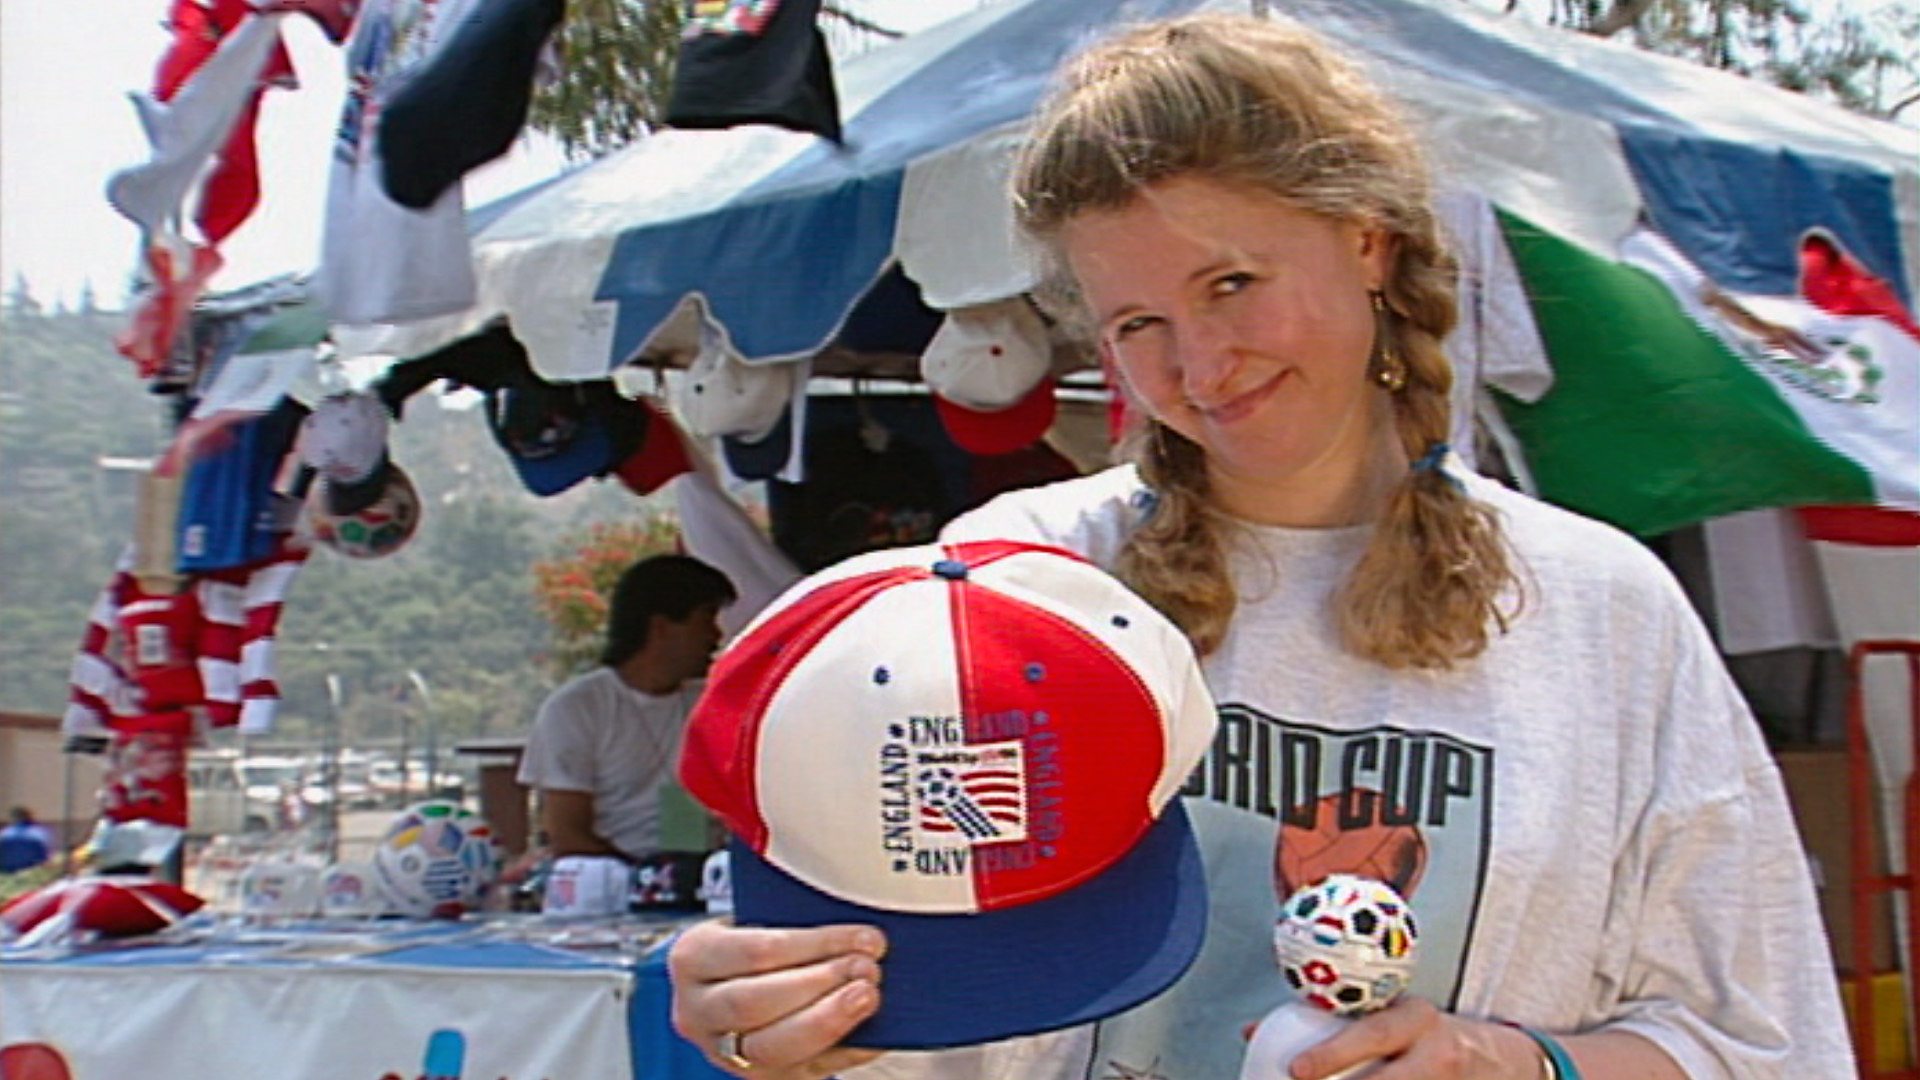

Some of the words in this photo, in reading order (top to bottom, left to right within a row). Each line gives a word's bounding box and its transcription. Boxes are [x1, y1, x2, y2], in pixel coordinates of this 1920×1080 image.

[880, 743, 913, 852] ENGLAND
[1181, 714, 1321, 830] RLD
[1339, 735, 1473, 831] CUP
